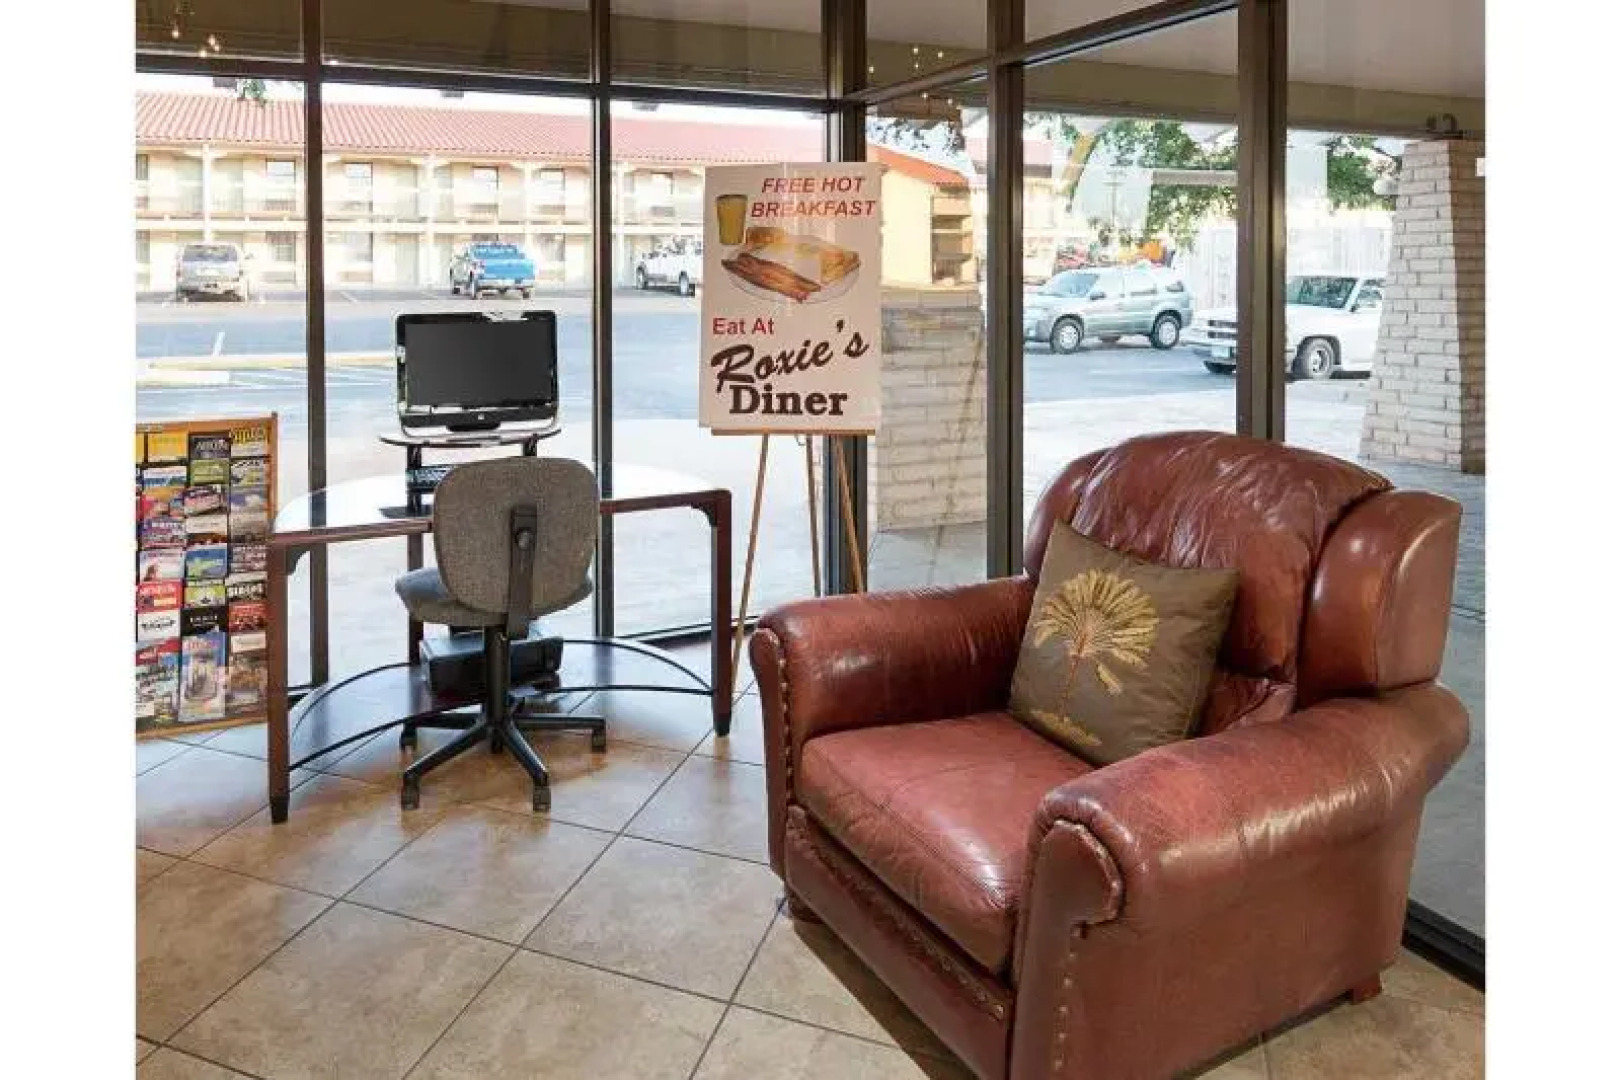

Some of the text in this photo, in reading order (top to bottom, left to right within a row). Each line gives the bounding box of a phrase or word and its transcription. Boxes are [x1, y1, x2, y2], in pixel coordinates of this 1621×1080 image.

[761, 177, 866, 193] FREE HOT
[751, 200, 876, 218] BREAKFAST
[712, 317, 776, 335] Eat At
[711, 319, 870, 393] Roxie's
[729, 384, 848, 416] Diner
